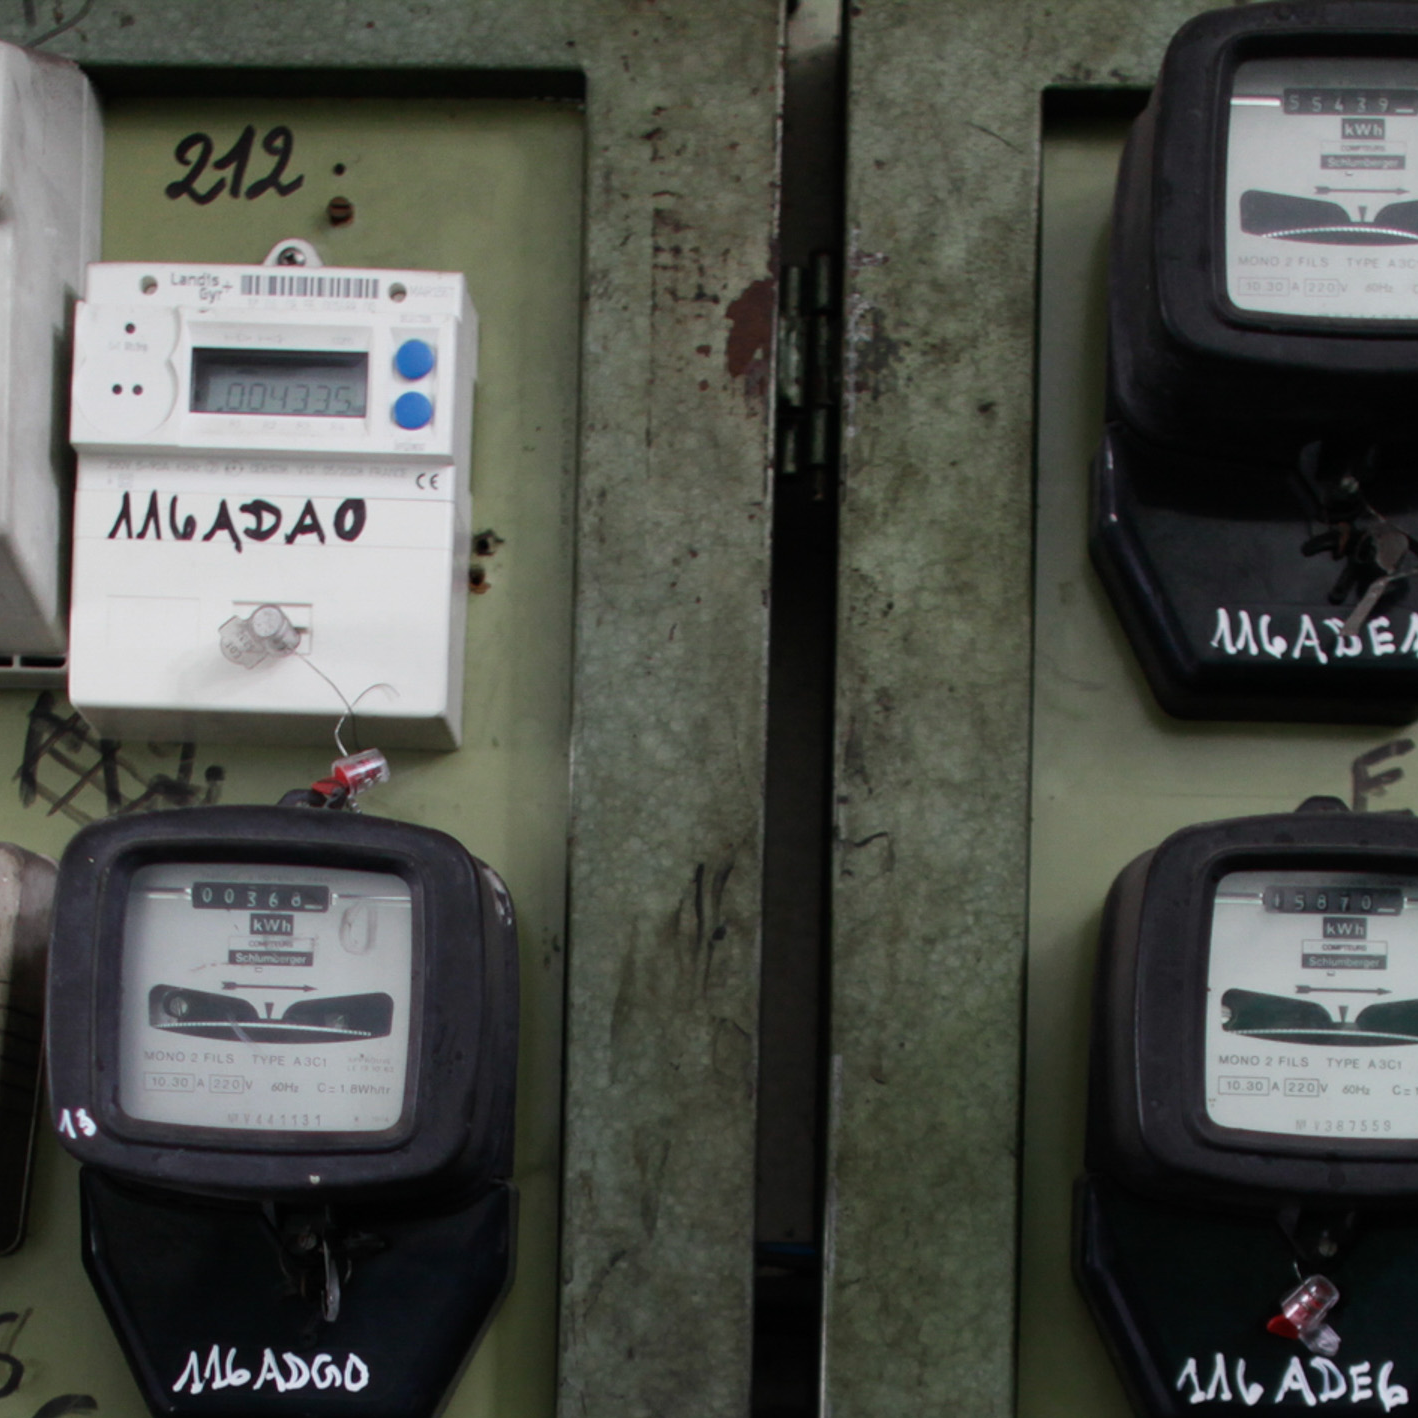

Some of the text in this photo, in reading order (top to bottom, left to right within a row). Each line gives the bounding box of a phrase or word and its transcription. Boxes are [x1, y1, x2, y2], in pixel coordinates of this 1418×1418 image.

[1344, 122, 1383, 137] kWh
[252, 918, 292, 933] kWh
[1325, 921, 1365, 936] kWh
[1308, 955, 1380, 970] Schlumberger
[1219, 1054, 1261, 1067] MONO
[1279, 1056, 1310, 1068] FILS
[1326, 1057, 1360, 1069] TYPE
[1288, 1081, 1316, 1094] 220
